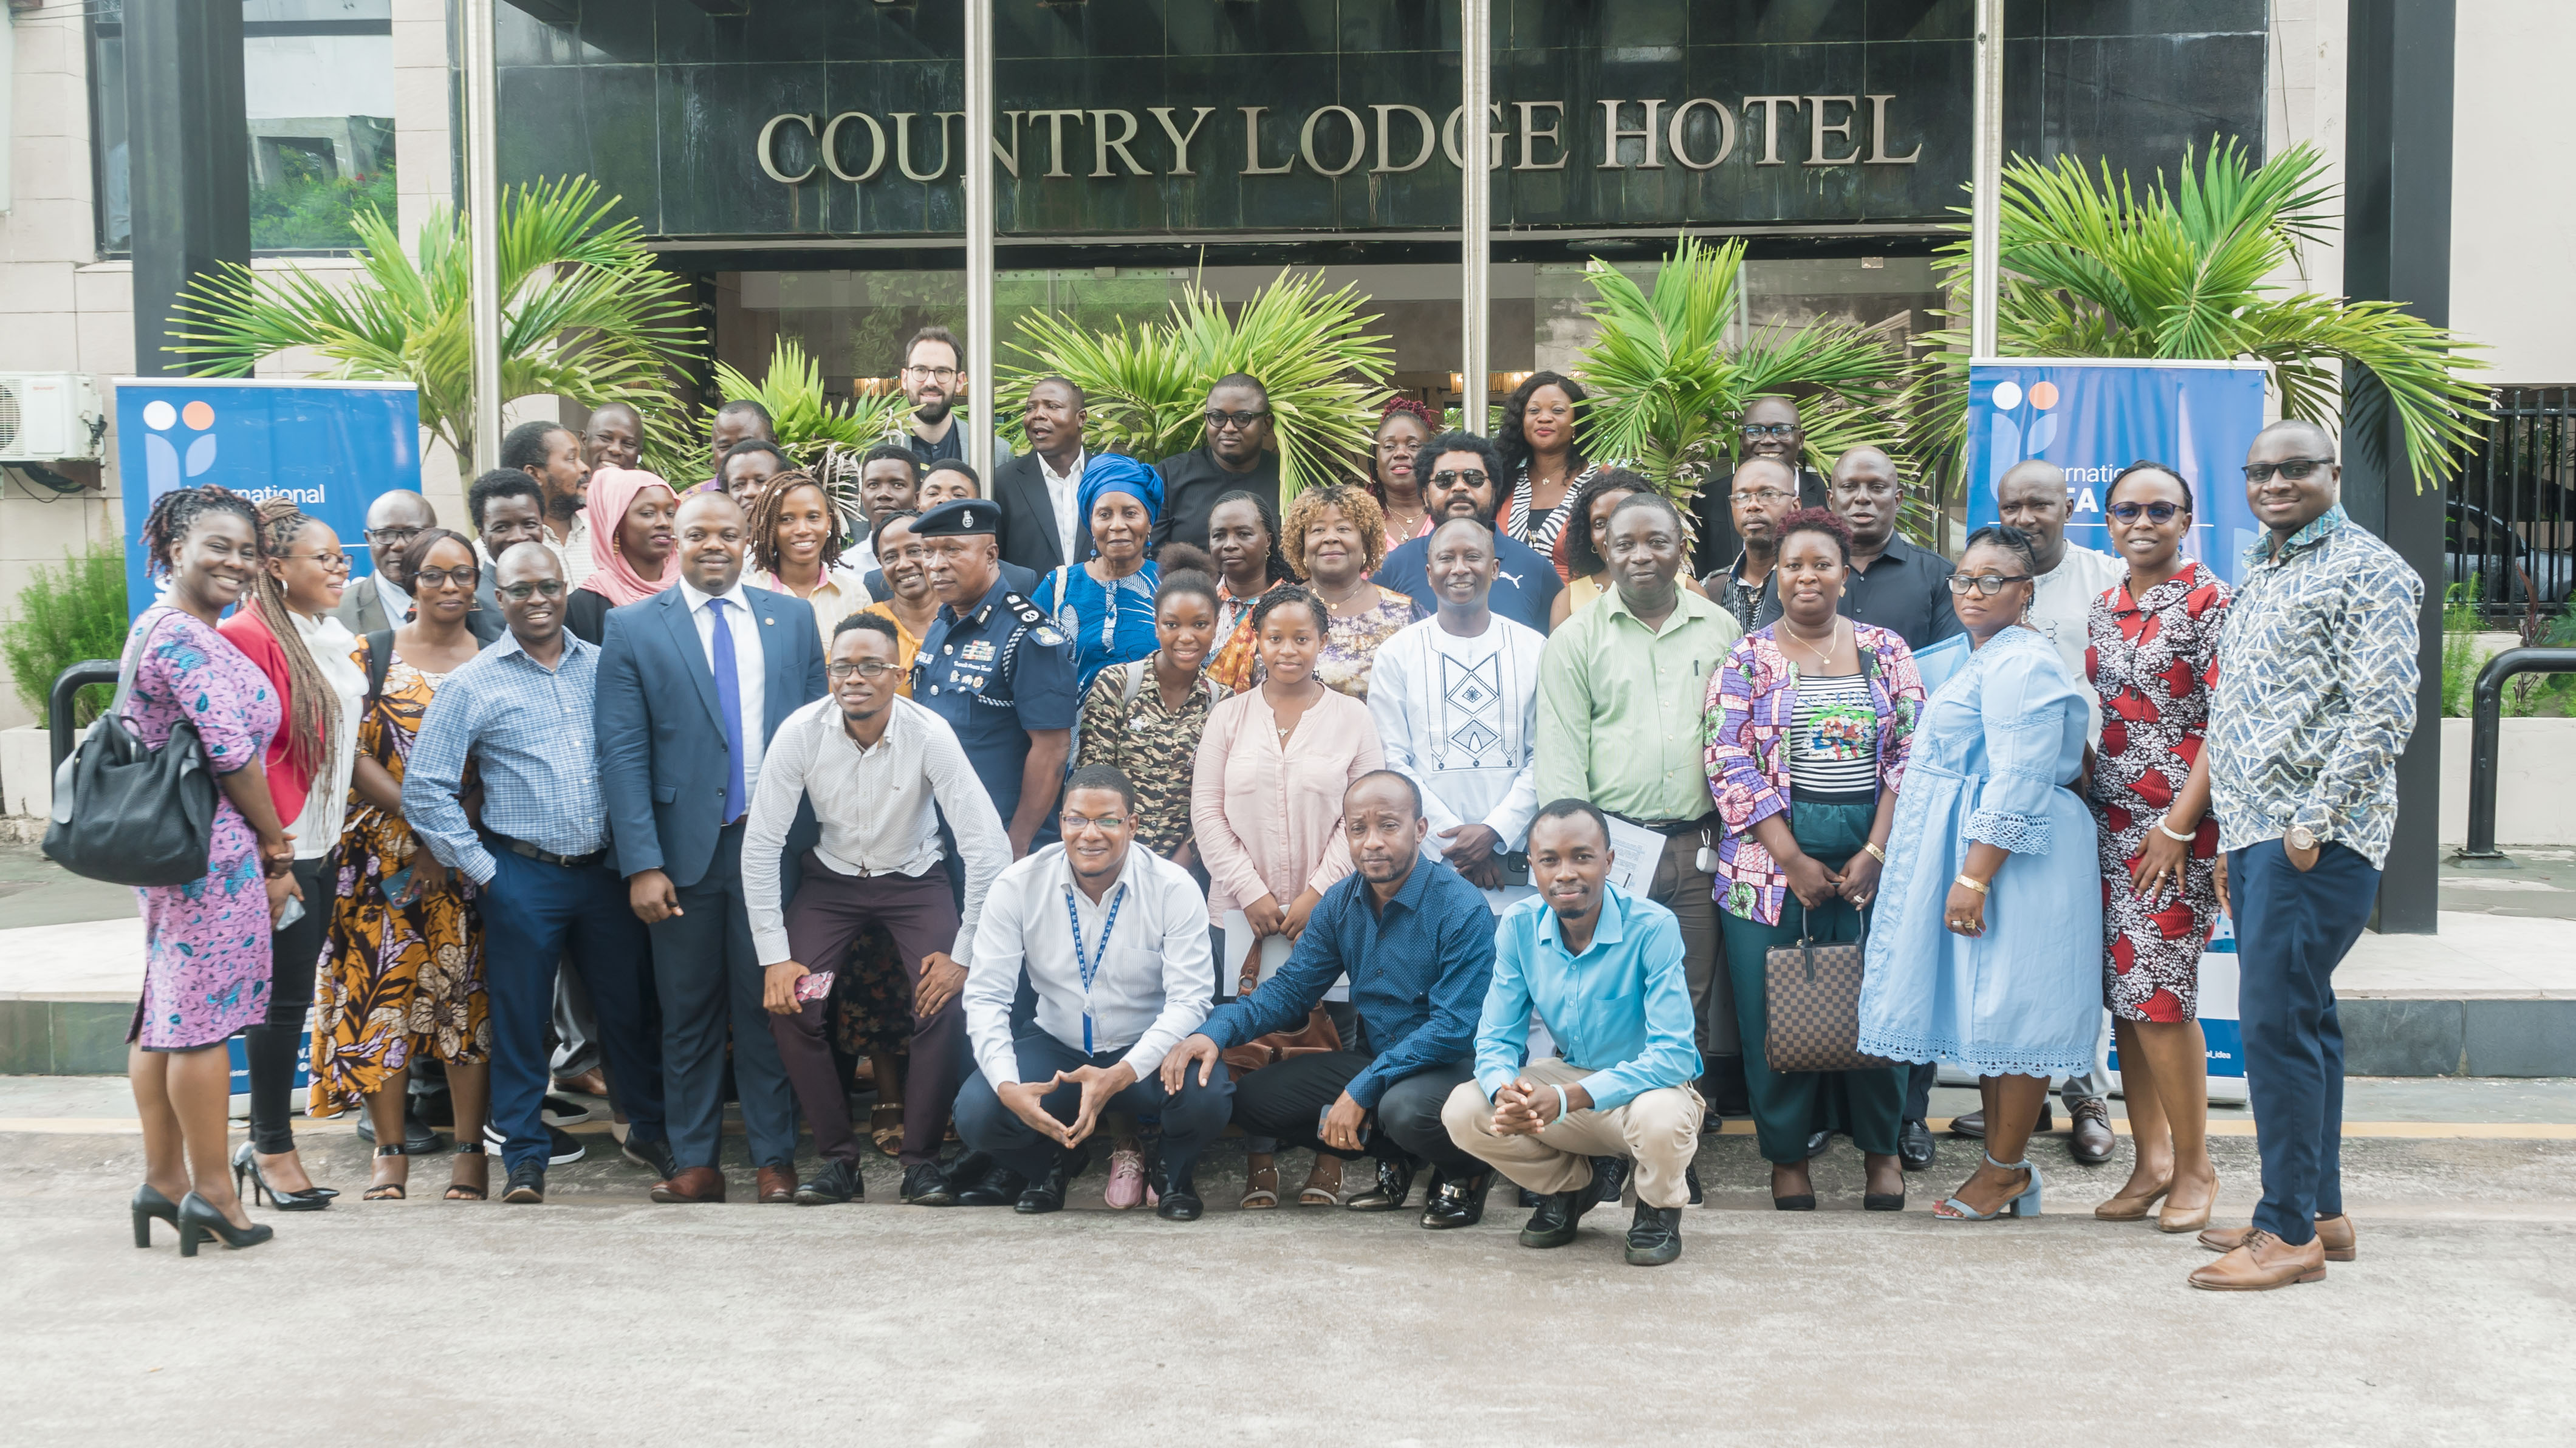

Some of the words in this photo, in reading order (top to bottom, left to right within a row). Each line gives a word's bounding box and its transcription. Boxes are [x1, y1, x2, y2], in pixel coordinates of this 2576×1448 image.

[758, 107, 1216, 183] COUNTRY
[1237, 101, 1569, 176] LODGE
[1597, 95, 1922, 170] HOTEL
